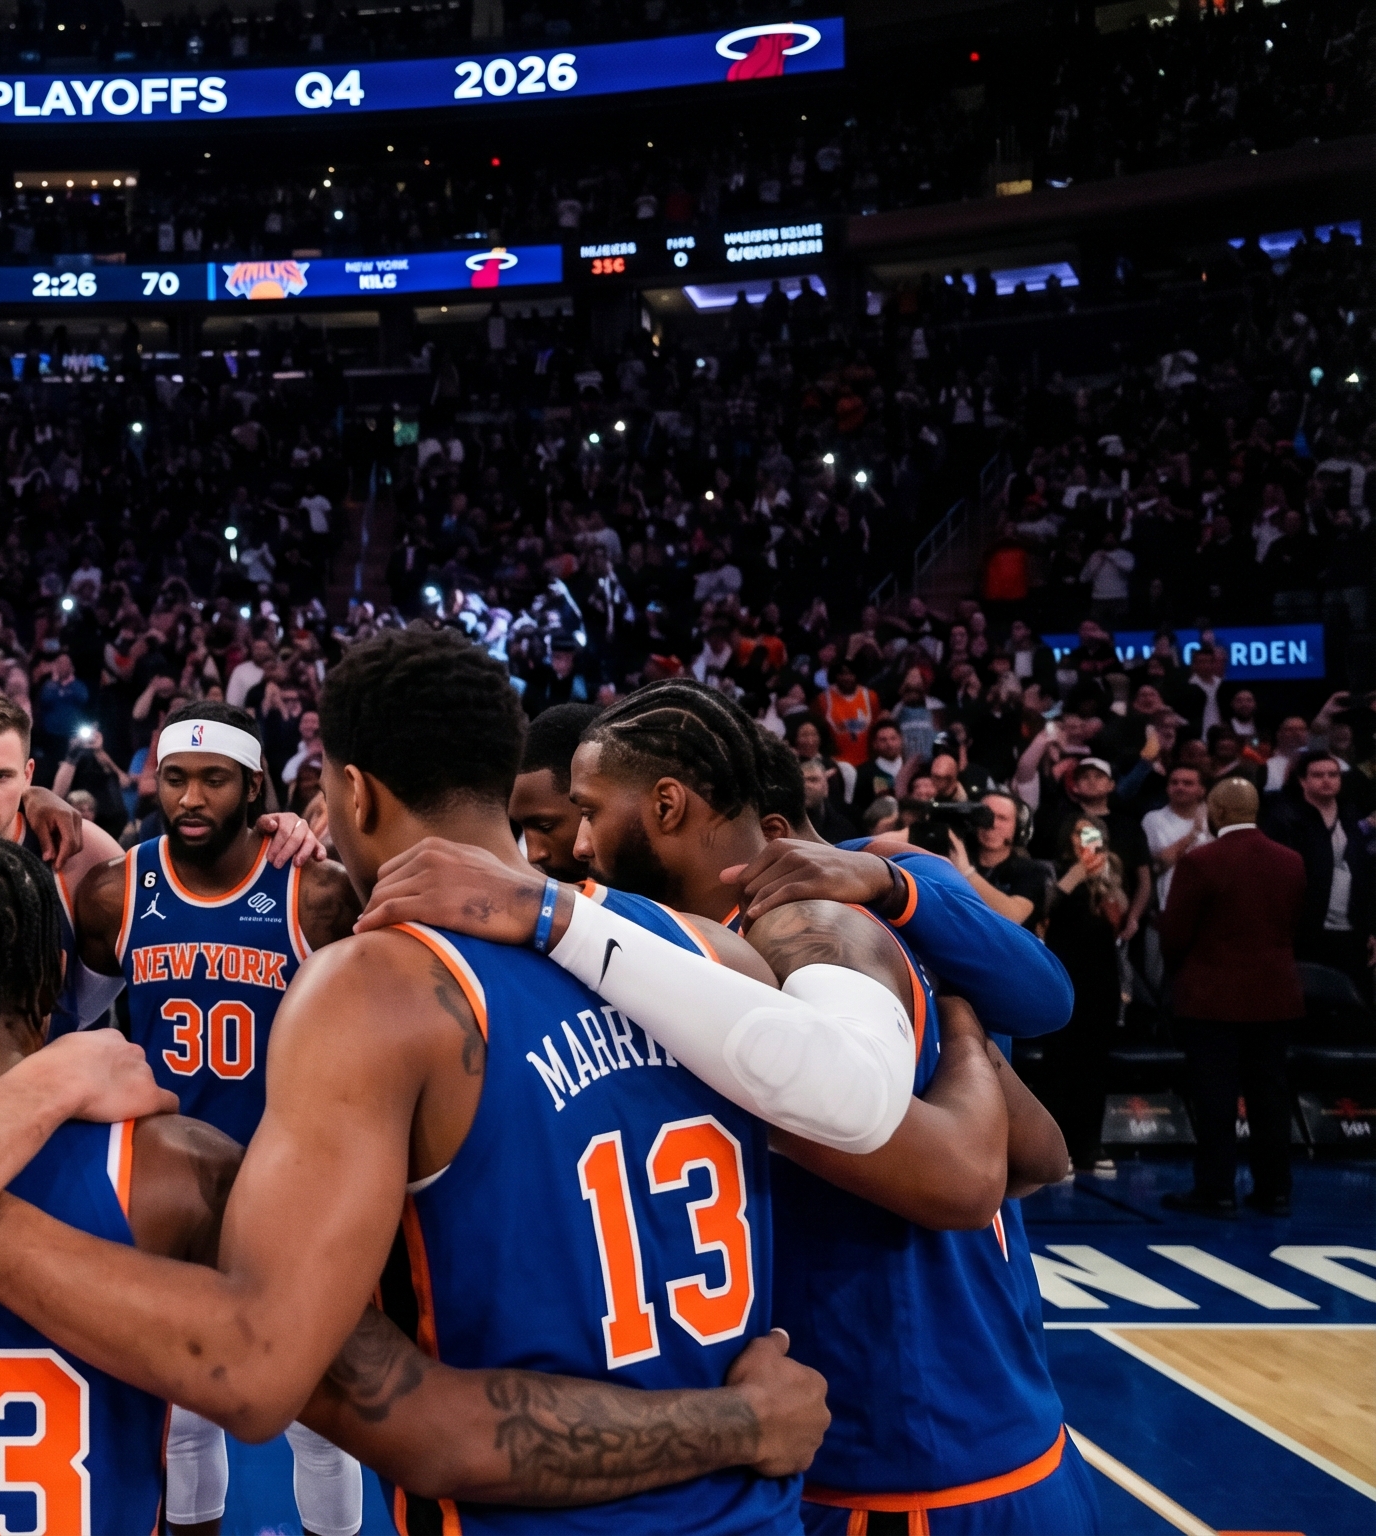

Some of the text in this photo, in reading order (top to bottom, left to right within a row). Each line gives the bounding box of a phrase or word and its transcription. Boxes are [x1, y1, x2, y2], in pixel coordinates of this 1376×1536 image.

[294, 69, 365, 109] Q4
[453, 52, 578, 99] 2026
[32, 272, 97, 297] 2:26
[141, 271, 180, 296] 70
[131, 941, 288, 991] NEW YORK
[160, 997, 256, 1080] 30
[576, 1113, 755, 1370] 13
